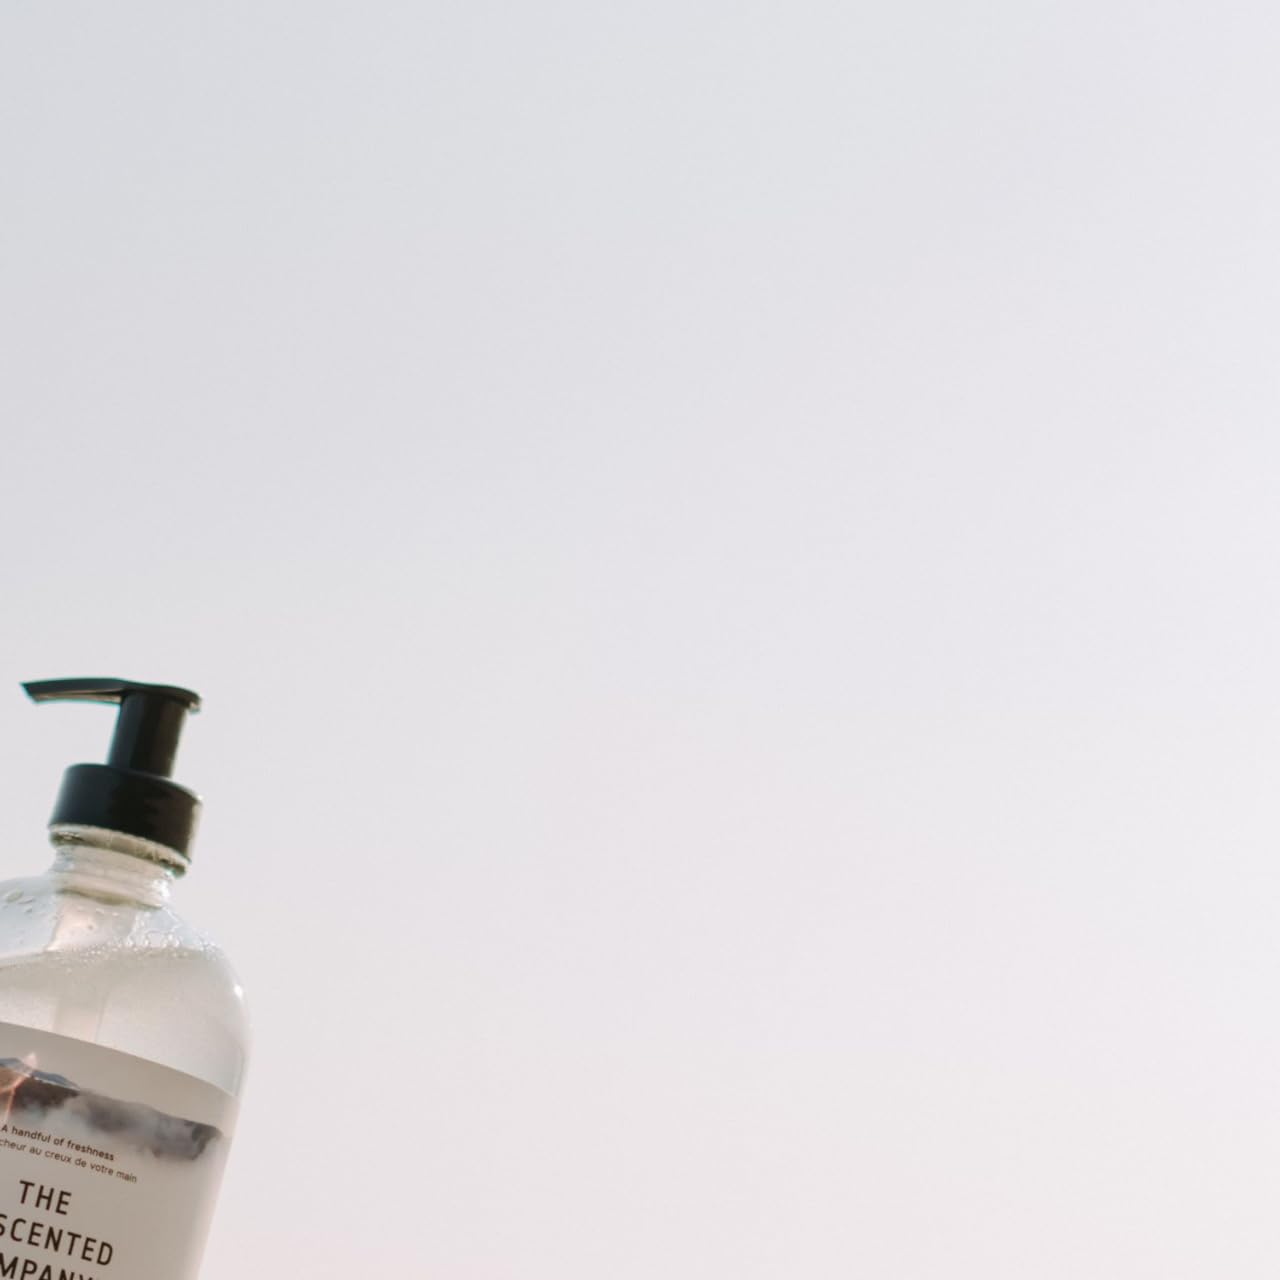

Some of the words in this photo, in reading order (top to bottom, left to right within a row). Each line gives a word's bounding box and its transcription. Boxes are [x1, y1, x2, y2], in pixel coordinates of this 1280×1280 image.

[1, 1124, 9, 1133] A
[11, 1124, 51, 1144] handful
[53, 1137, 64, 1147] of
[67, 1139, 115, 1161] freshness
[29, 1146, 42, 1156] au
[44, 1150, 72, 1164] creux
[74, 1157, 87, 1168] de
[90, 1162, 114, 1176] votre
[116, 1170, 138, 1183] main
[19, 1180, 72, 1215] THE
